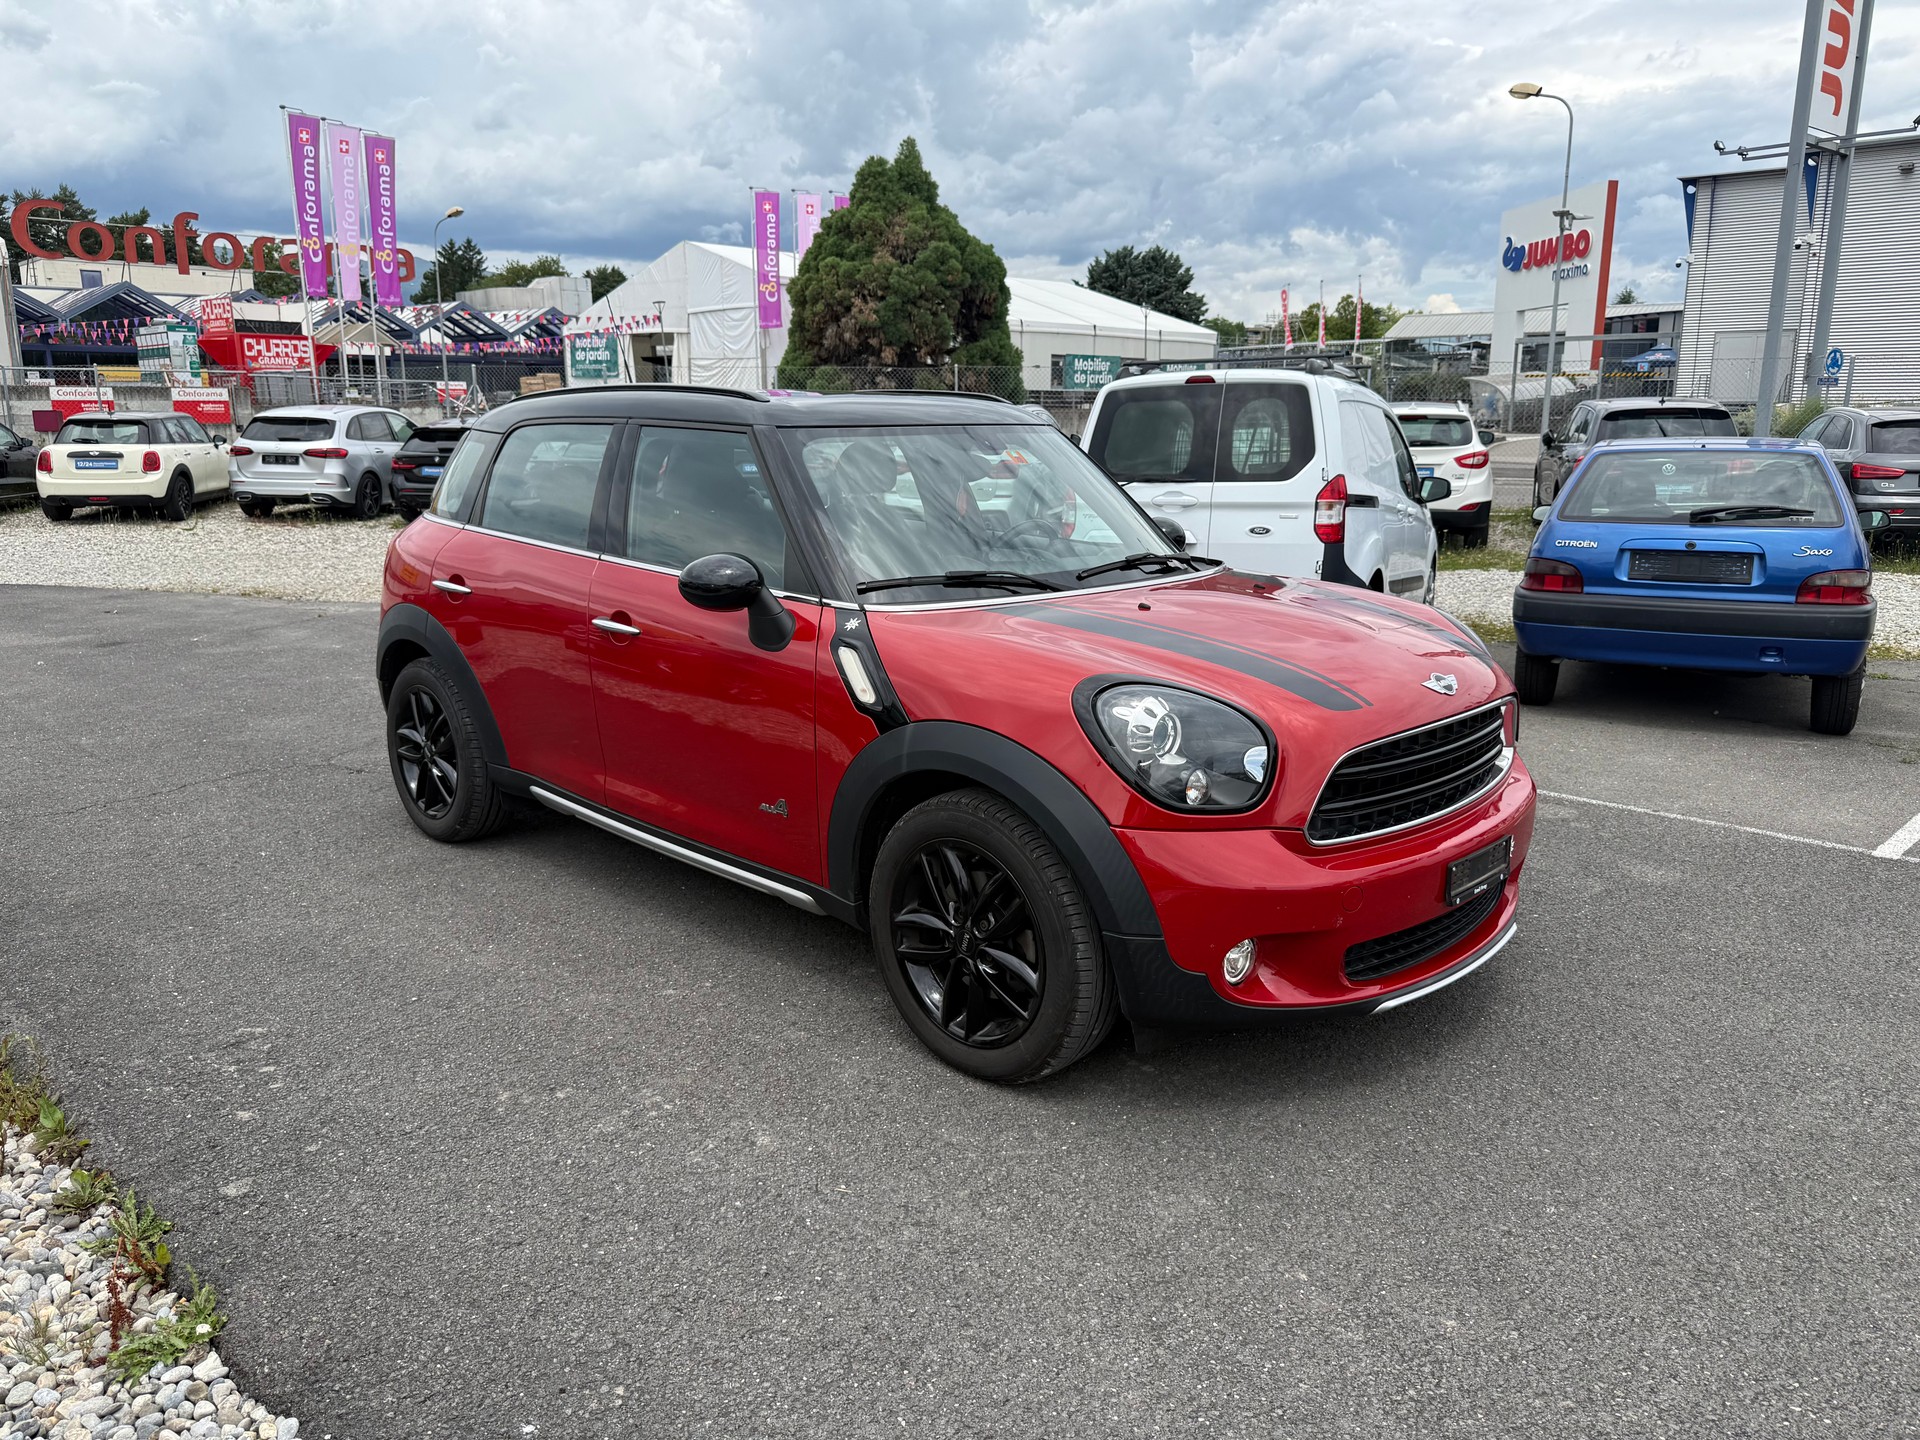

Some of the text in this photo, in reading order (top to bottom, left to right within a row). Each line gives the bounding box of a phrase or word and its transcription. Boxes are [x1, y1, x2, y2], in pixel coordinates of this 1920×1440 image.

[1523, 229, 1591, 270] JUMBO
[244, 338, 310, 358] CHURROS
[258, 356, 299, 370] GRANITAS
[575, 348, 610, 364] de jardin
[1074, 358, 1111, 371] Mobilier
[1074, 371, 1113, 387] de jardin
[177, 389, 223, 398] Conforama
[1555, 539, 1598, 548] CITROËN
[1792, 545, 1834, 557] Saxo
